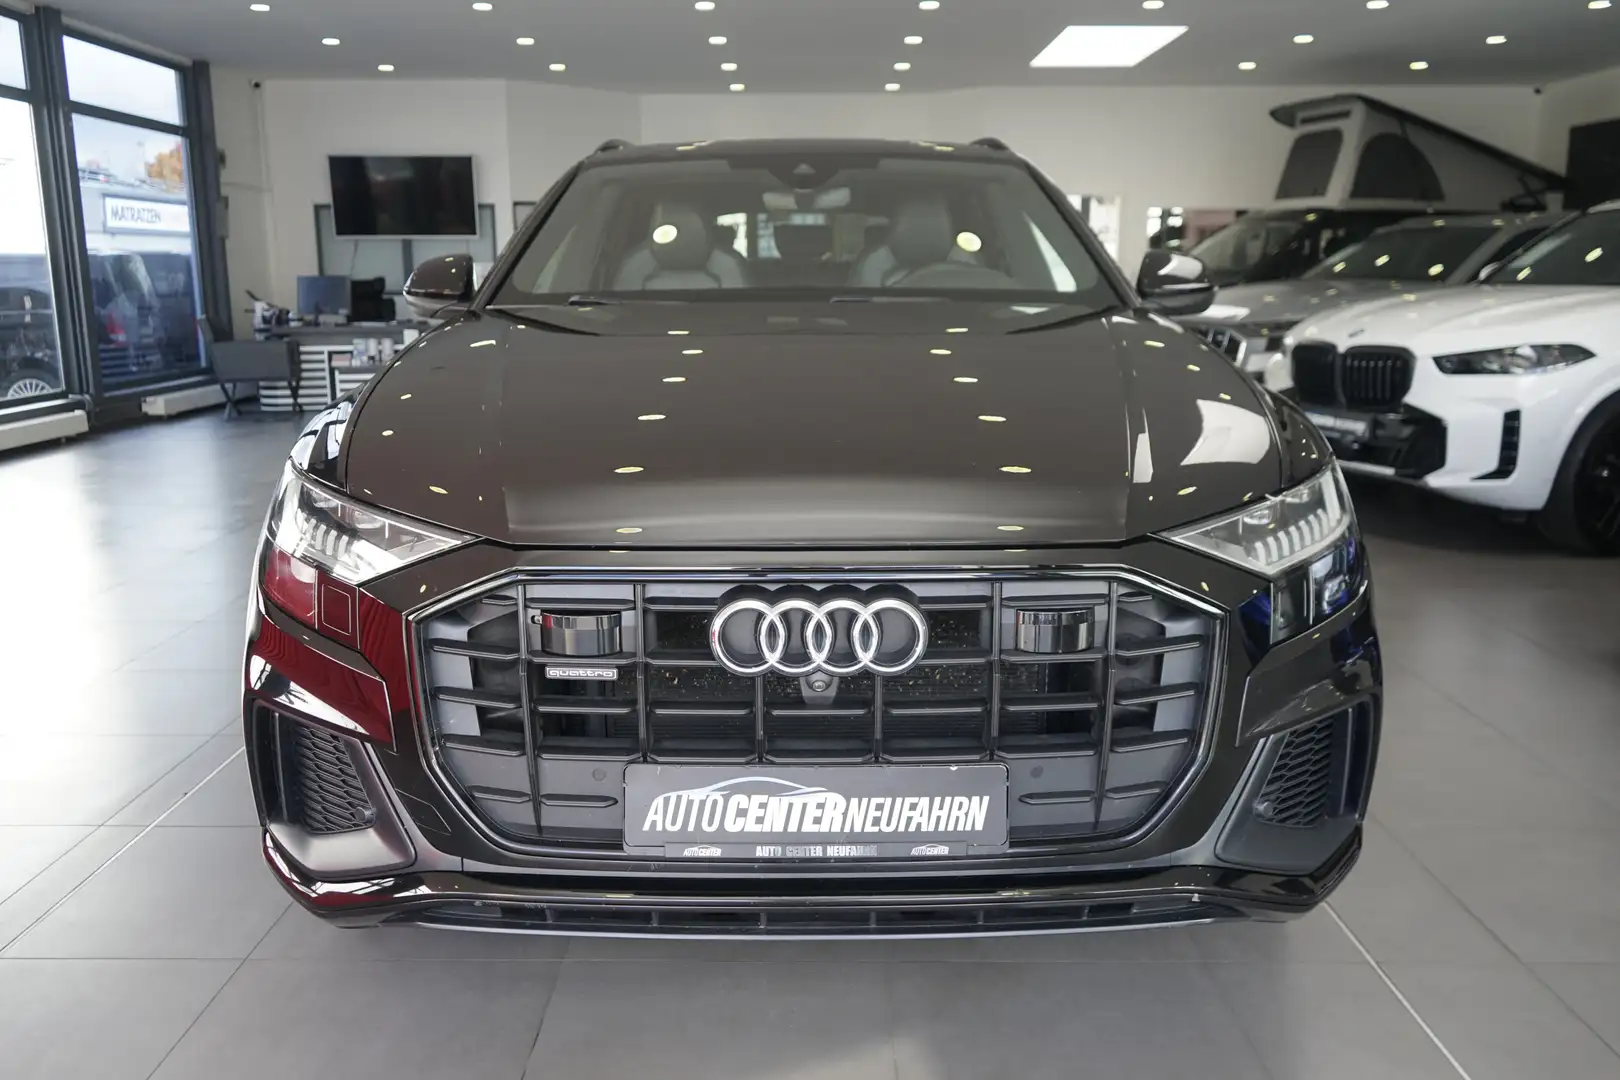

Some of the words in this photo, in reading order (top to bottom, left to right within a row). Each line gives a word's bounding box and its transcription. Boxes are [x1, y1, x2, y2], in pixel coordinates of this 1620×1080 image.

[110, 205, 162, 224] MATRATZEN
[549, 670, 613, 678] quattro
[755, 846, 781, 857] AUTO
[786, 846, 823, 857] CENTER
